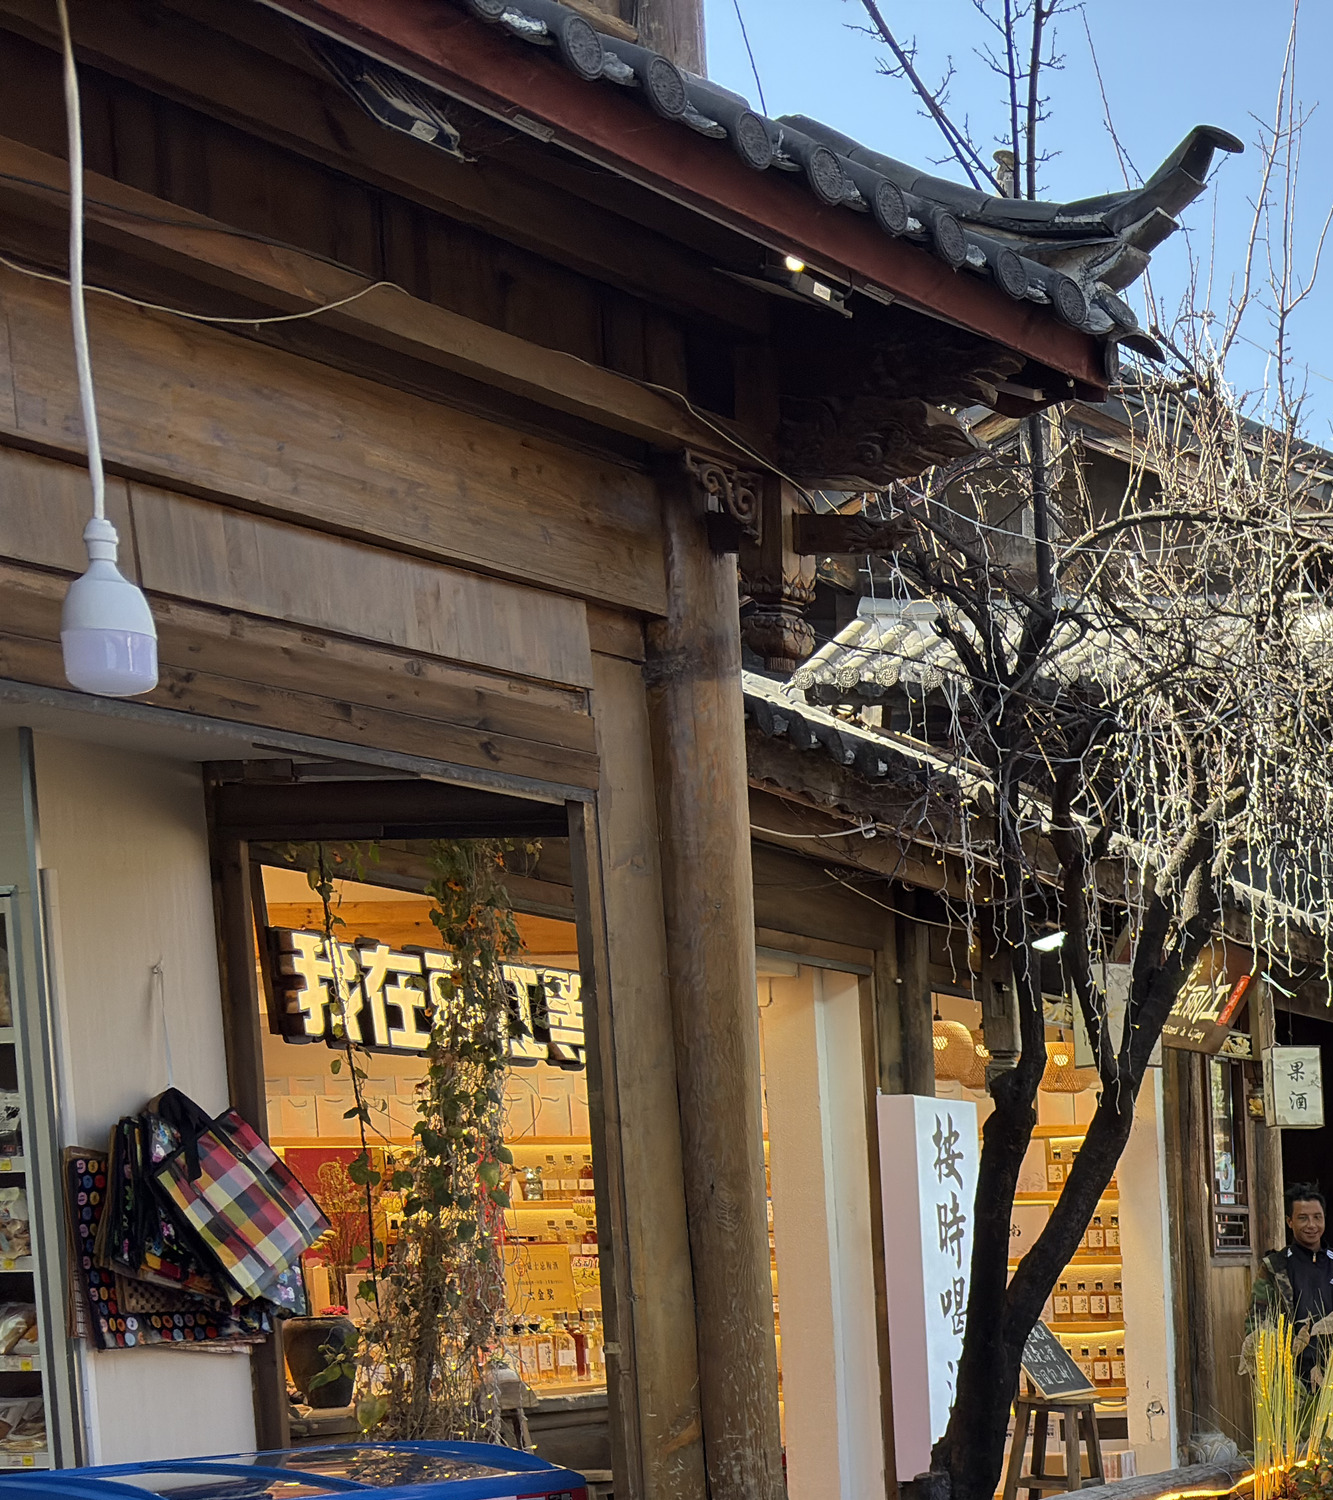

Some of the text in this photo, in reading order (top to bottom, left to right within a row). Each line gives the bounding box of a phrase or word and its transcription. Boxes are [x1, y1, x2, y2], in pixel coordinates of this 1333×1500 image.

[1287, 1060, 1308, 1111] 果酒
[932, 1112, 968, 1400] 按時喝
